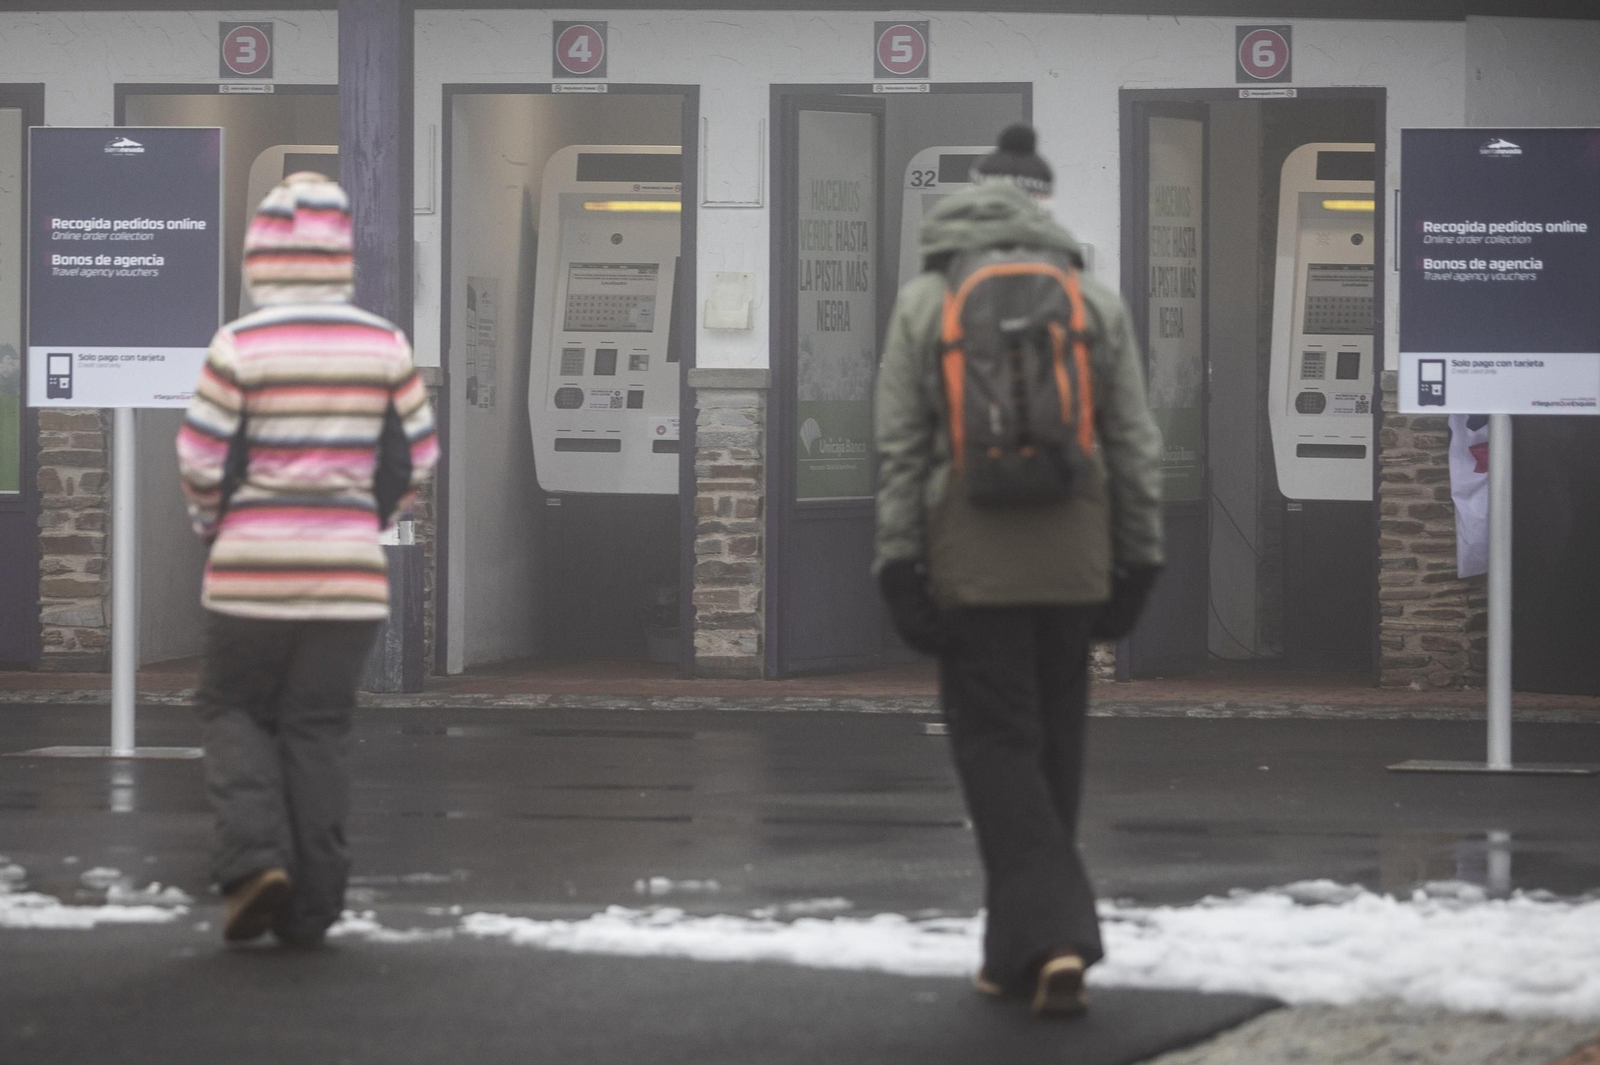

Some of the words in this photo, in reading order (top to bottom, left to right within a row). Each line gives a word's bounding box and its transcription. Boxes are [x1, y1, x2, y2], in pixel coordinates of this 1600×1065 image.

[235, 35, 257, 64] 3
[568, 35, 592, 63] 4
[890, 35, 913, 63] 5
[1252, 39, 1276, 68] 6
[910, 169, 936, 188] 32
[811, 179, 861, 212] HACEMOS
[51, 217, 111, 232] Recogida
[113, 217, 165, 232] pedidos
[166, 217, 207, 230] online
[1423, 220, 1487, 235] Recogida
[1488, 220, 1543, 235] pedidos
[1545, 220, 1588, 233] online
[51, 231, 81, 241] Online
[82, 231, 108, 241] order
[109, 231, 154, 241] collection
[799, 218, 834, 251] VERDE
[835, 220, 868, 252] HASTA
[1423, 235, 1455, 244] Online
[1455, 235, 1482, 244] order
[1484, 235, 1532, 244] collection
[51, 254, 93, 266] Bonos
[95, 254, 111, 266] de
[113, 253, 165, 268] agencia
[1423, 258, 1467, 270] Bonos
[1469, 258, 1487, 270] de
[1488, 257, 1543, 271] agencia
[51, 267, 79, 277] Travel
[80, 268, 115, 278] agency
[115, 267, 159, 277] vouchers
[799, 259, 812, 292] LA
[815, 259, 843, 292] PISTA
[845, 254, 869, 293] MÁS
[1424, 271, 1452, 281] Travel
[1453, 272, 1489, 282] agency
[1490, 271, 1537, 281] vouchers
[816, 299, 851, 332] NEGRA
[78, 353, 97, 362] Solo
[97, 354, 119, 364] pago
[120, 354, 135, 362] con
[136, 353, 166, 363] tarjeta
[1451, 359, 1471, 368] Solo
[1472, 360, 1495, 370] pago
[1496, 360, 1512, 368] con
[1513, 359, 1545, 370] tarjeta
